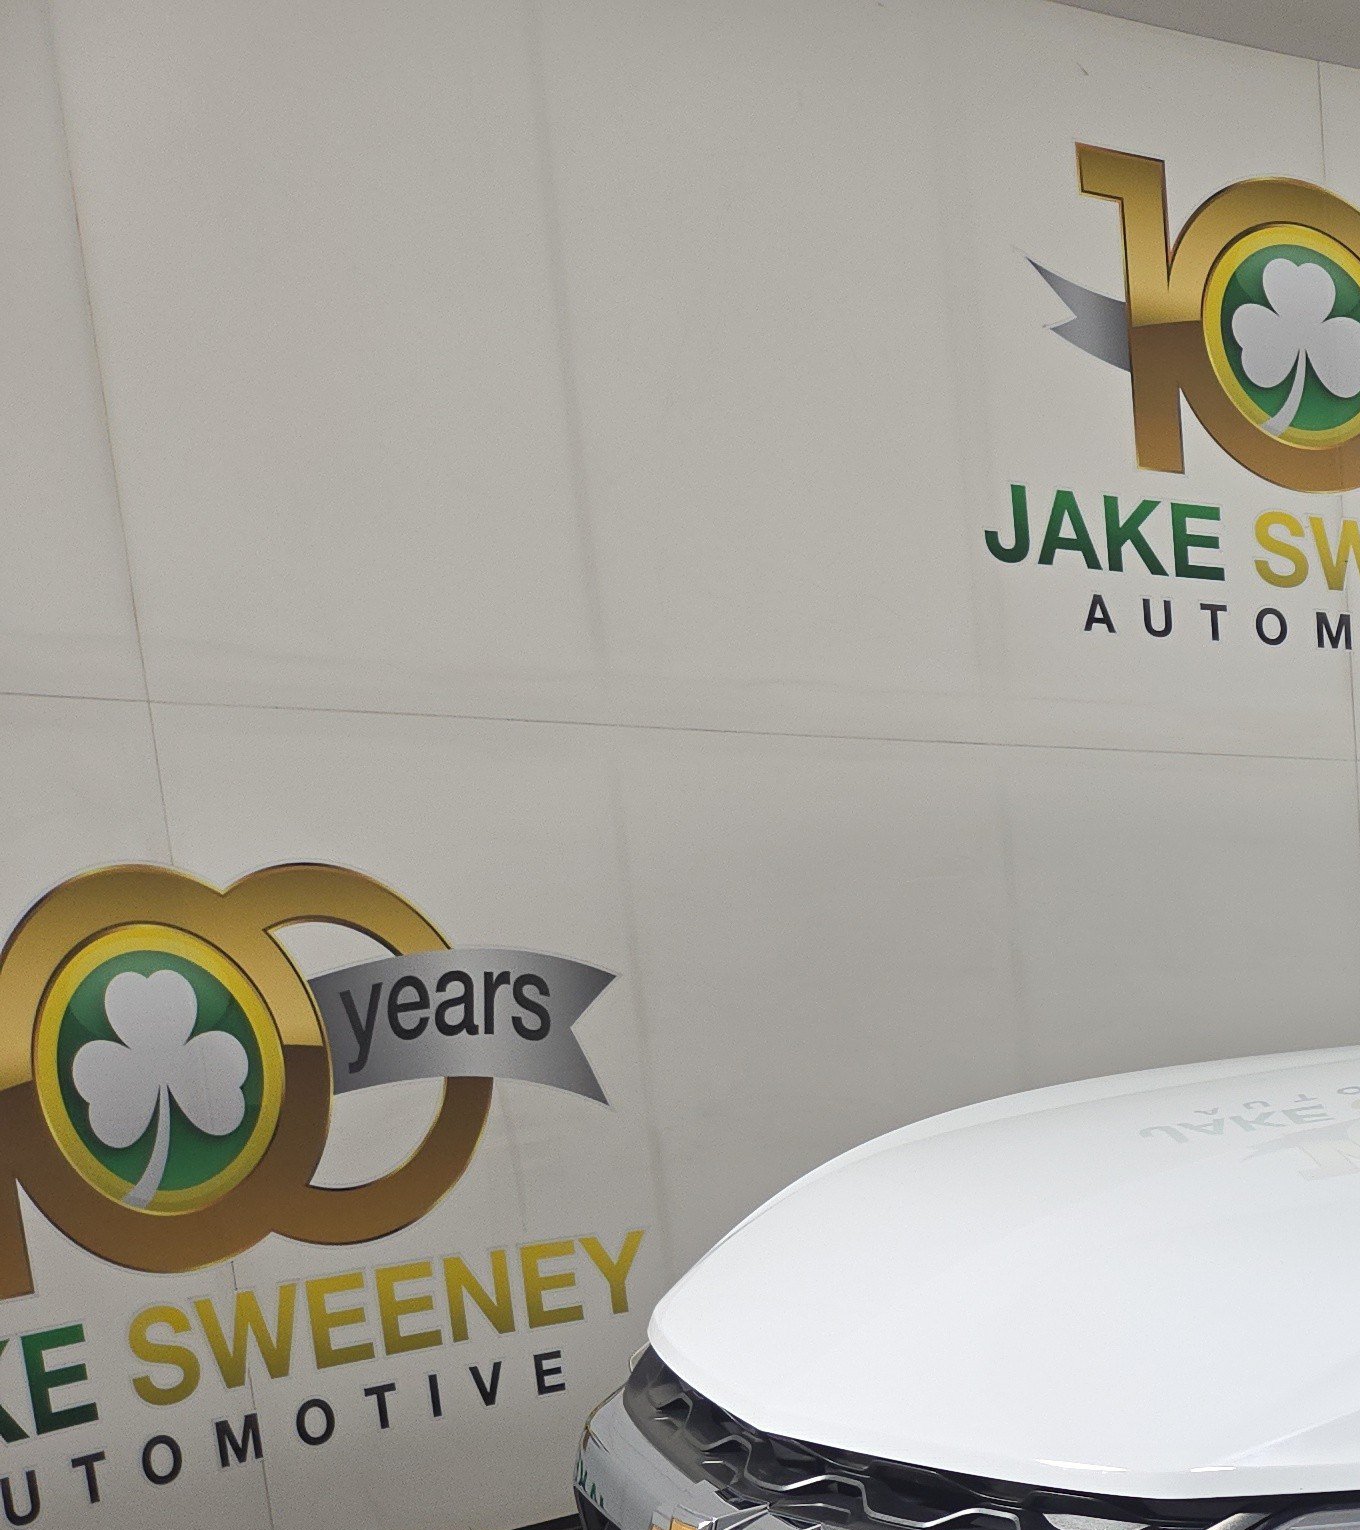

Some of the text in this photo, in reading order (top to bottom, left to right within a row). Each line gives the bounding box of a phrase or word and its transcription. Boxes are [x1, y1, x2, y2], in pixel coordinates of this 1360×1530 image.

[984, 484, 1225, 581] JAKE
[339, 969, 551, 1074] years
[128, 1230, 645, 1405] SWEENEY
